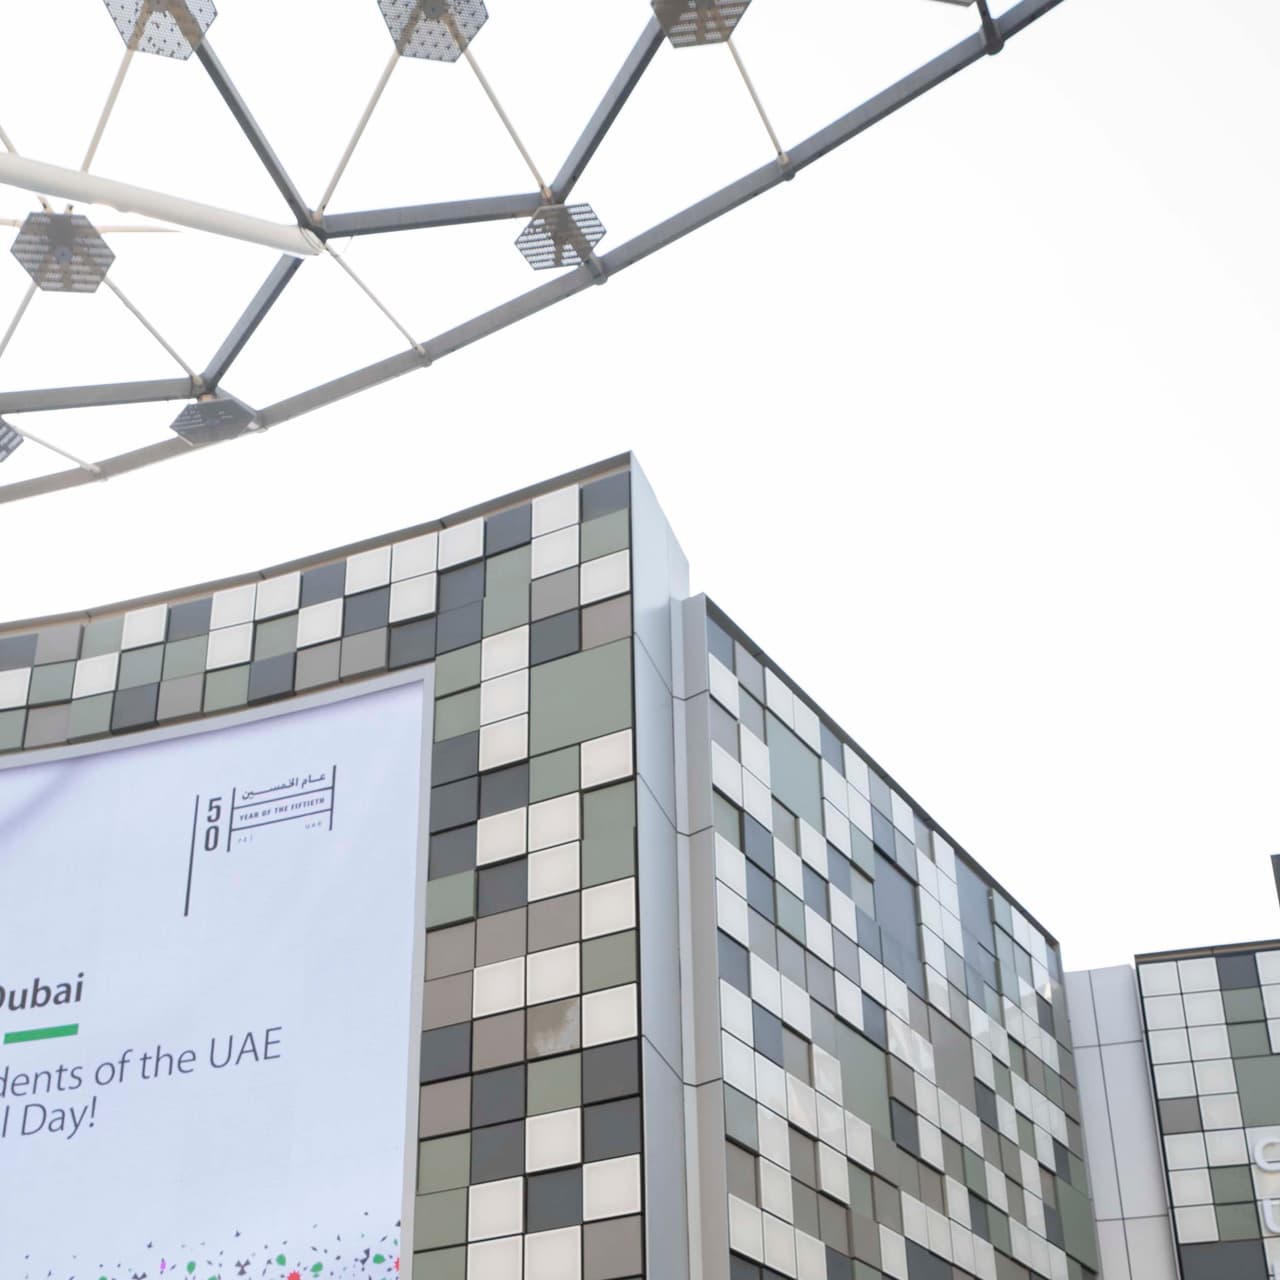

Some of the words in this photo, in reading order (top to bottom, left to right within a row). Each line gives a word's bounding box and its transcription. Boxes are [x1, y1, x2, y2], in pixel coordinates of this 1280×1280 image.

[239, 811, 259, 822] YEAR
[261, 809, 271, 817] OF
[274, 805, 289, 814] THE
[290, 797, 326, 811] FIFTIETH
[94, 1048, 134, 1087] of
[140, 1045, 197, 1081] the
[208, 1026, 283, 1069] UAE
[20, 1096, 97, 1140] Day!
